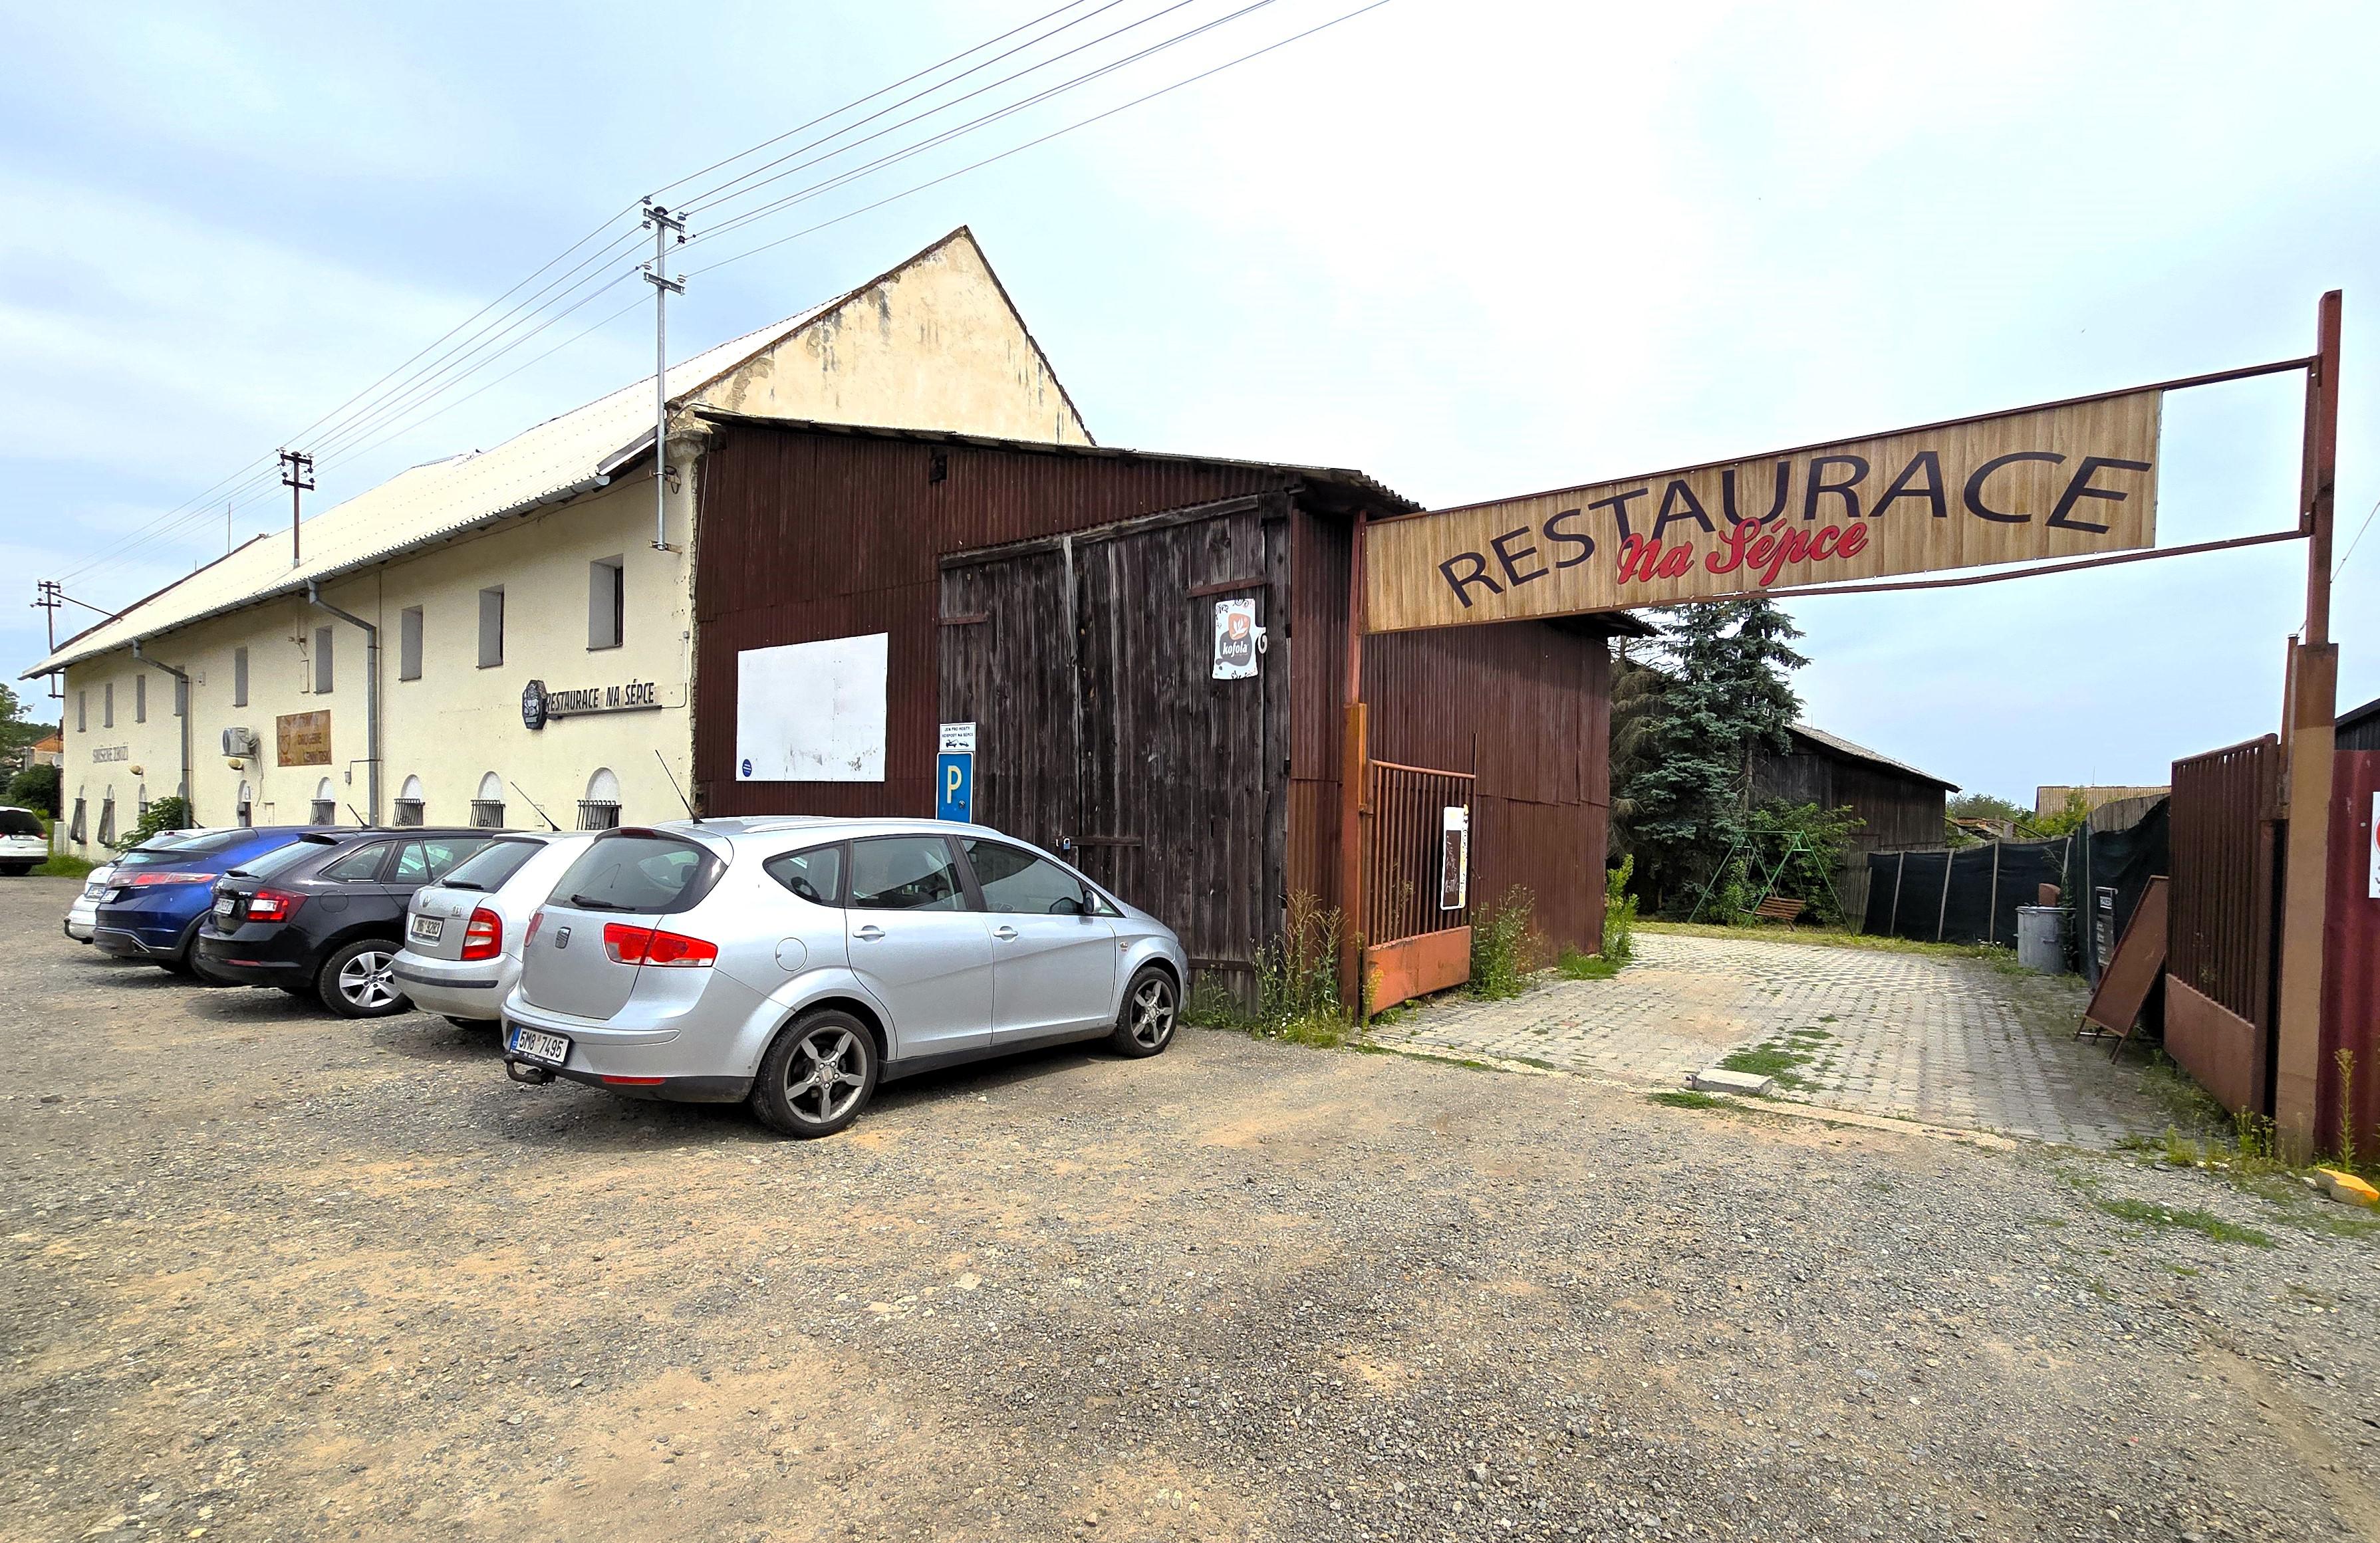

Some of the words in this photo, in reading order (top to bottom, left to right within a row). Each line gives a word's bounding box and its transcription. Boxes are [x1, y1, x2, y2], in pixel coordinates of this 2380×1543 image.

[1438, 451, 2153, 608] RESTAURACE
[1617, 533, 1694, 585] Na
[1705, 517, 1868, 586] Sépce
[1222, 640, 1248, 657] kofola
[547, 688, 599, 712] RESTAURACE
[606, 685, 620, 707] NA
[625, 679, 654, 705] SÉPCE
[946, 765, 962, 804] P
[519, 1031, 536, 1051] 5M8
[539, 1036, 564, 1058] 7495
